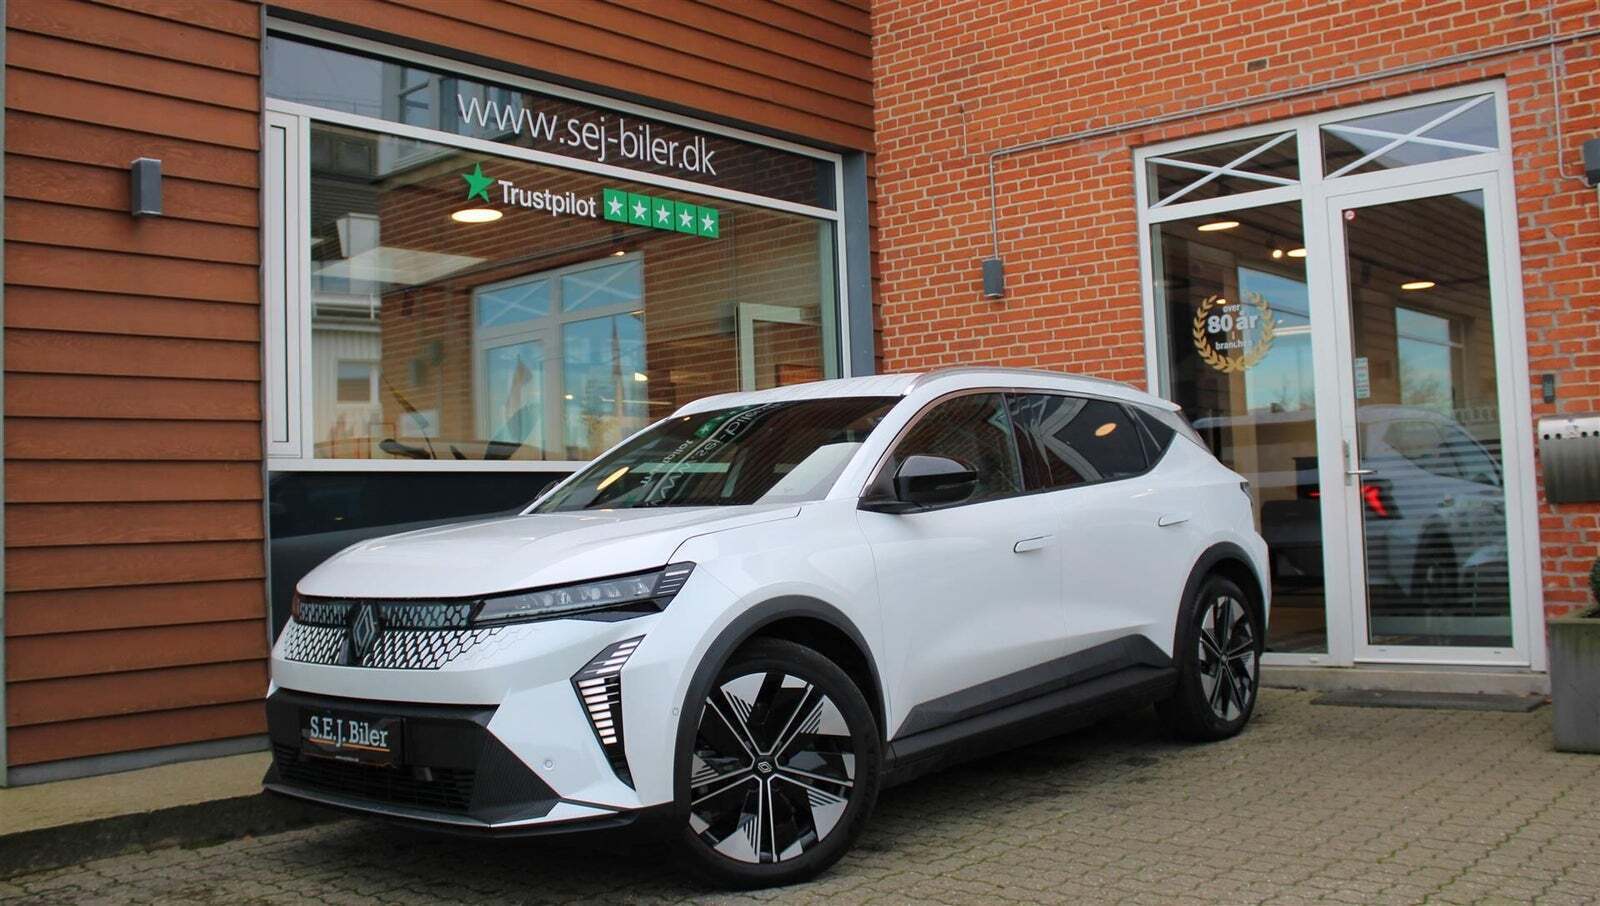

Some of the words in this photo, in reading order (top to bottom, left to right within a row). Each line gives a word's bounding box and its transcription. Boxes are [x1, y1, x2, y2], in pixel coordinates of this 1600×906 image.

[457, 93, 717, 176] www.sej-biler.dk
[498, 180, 597, 218] Trustpilot
[1207, 314, 1233, 333] 80
[1236, 311, 1258, 330] år
[1223, 304, 1241, 313] over
[310, 716, 346, 747] S.E.J.
[349, 720, 388, 747] Biler
